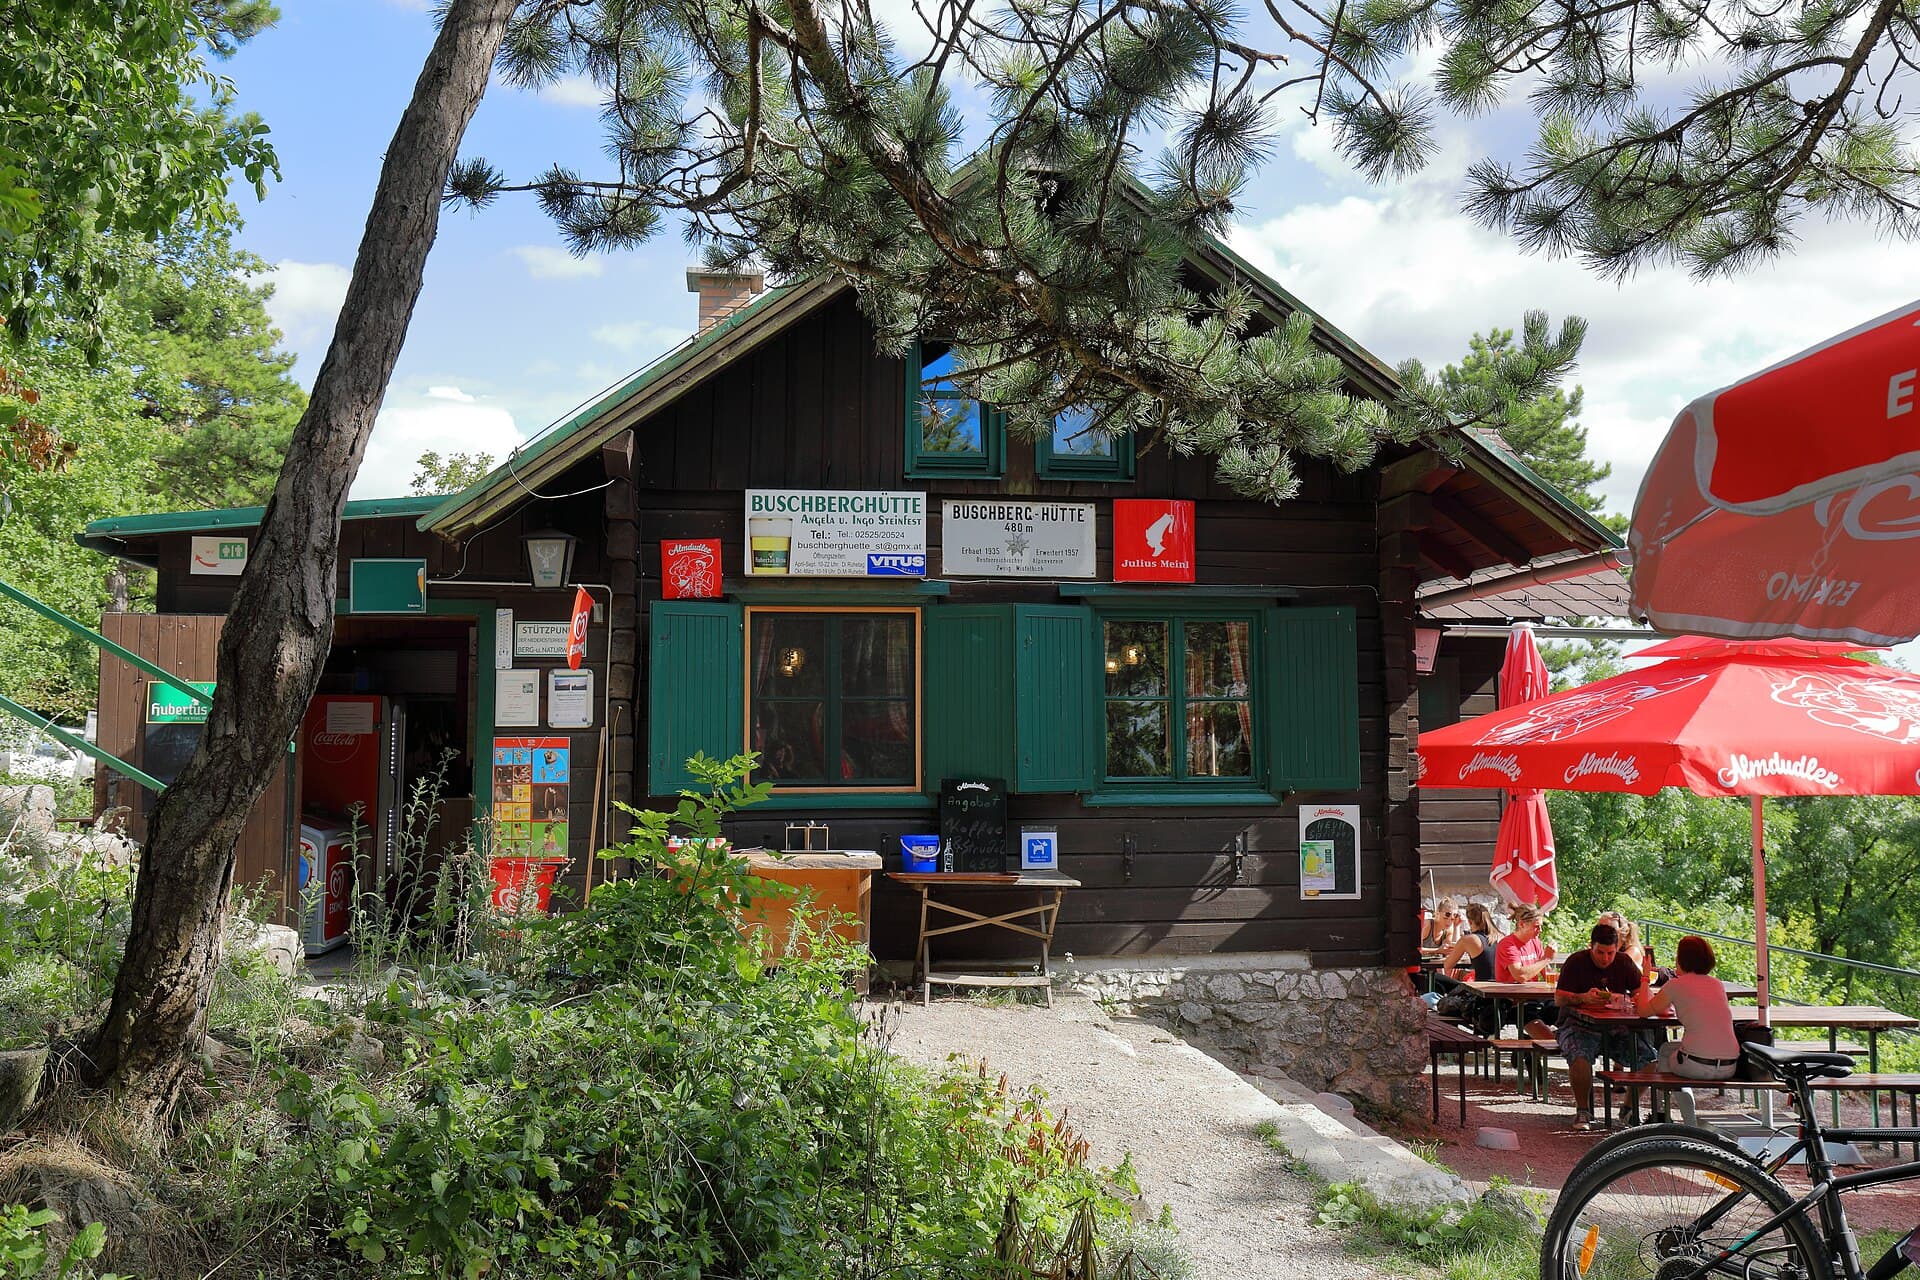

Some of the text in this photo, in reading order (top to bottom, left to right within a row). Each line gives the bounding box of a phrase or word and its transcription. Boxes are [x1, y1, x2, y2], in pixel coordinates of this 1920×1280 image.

[751, 493, 921, 514] BUSCHBERGHÜTTE
[1003, 522, 1033, 533] 480 m
[810, 530, 831, 539] Tel.:
[854, 531, 905, 539] 02525/20524
[668, 544, 712, 556] Almdudler
[1065, 548, 1079, 558] 1957
[870, 555, 925, 568] VITUS
[1121, 559, 1190, 569] Julius Meinl
[522, 624, 571, 634] STÜTZPUN
[151, 702, 207, 716] Hubertus
[1458, 750, 1521, 782] Almdudler
[1563, 751, 1640, 785] Almdudler
[1717, 751, 1839, 789] Almdudler
